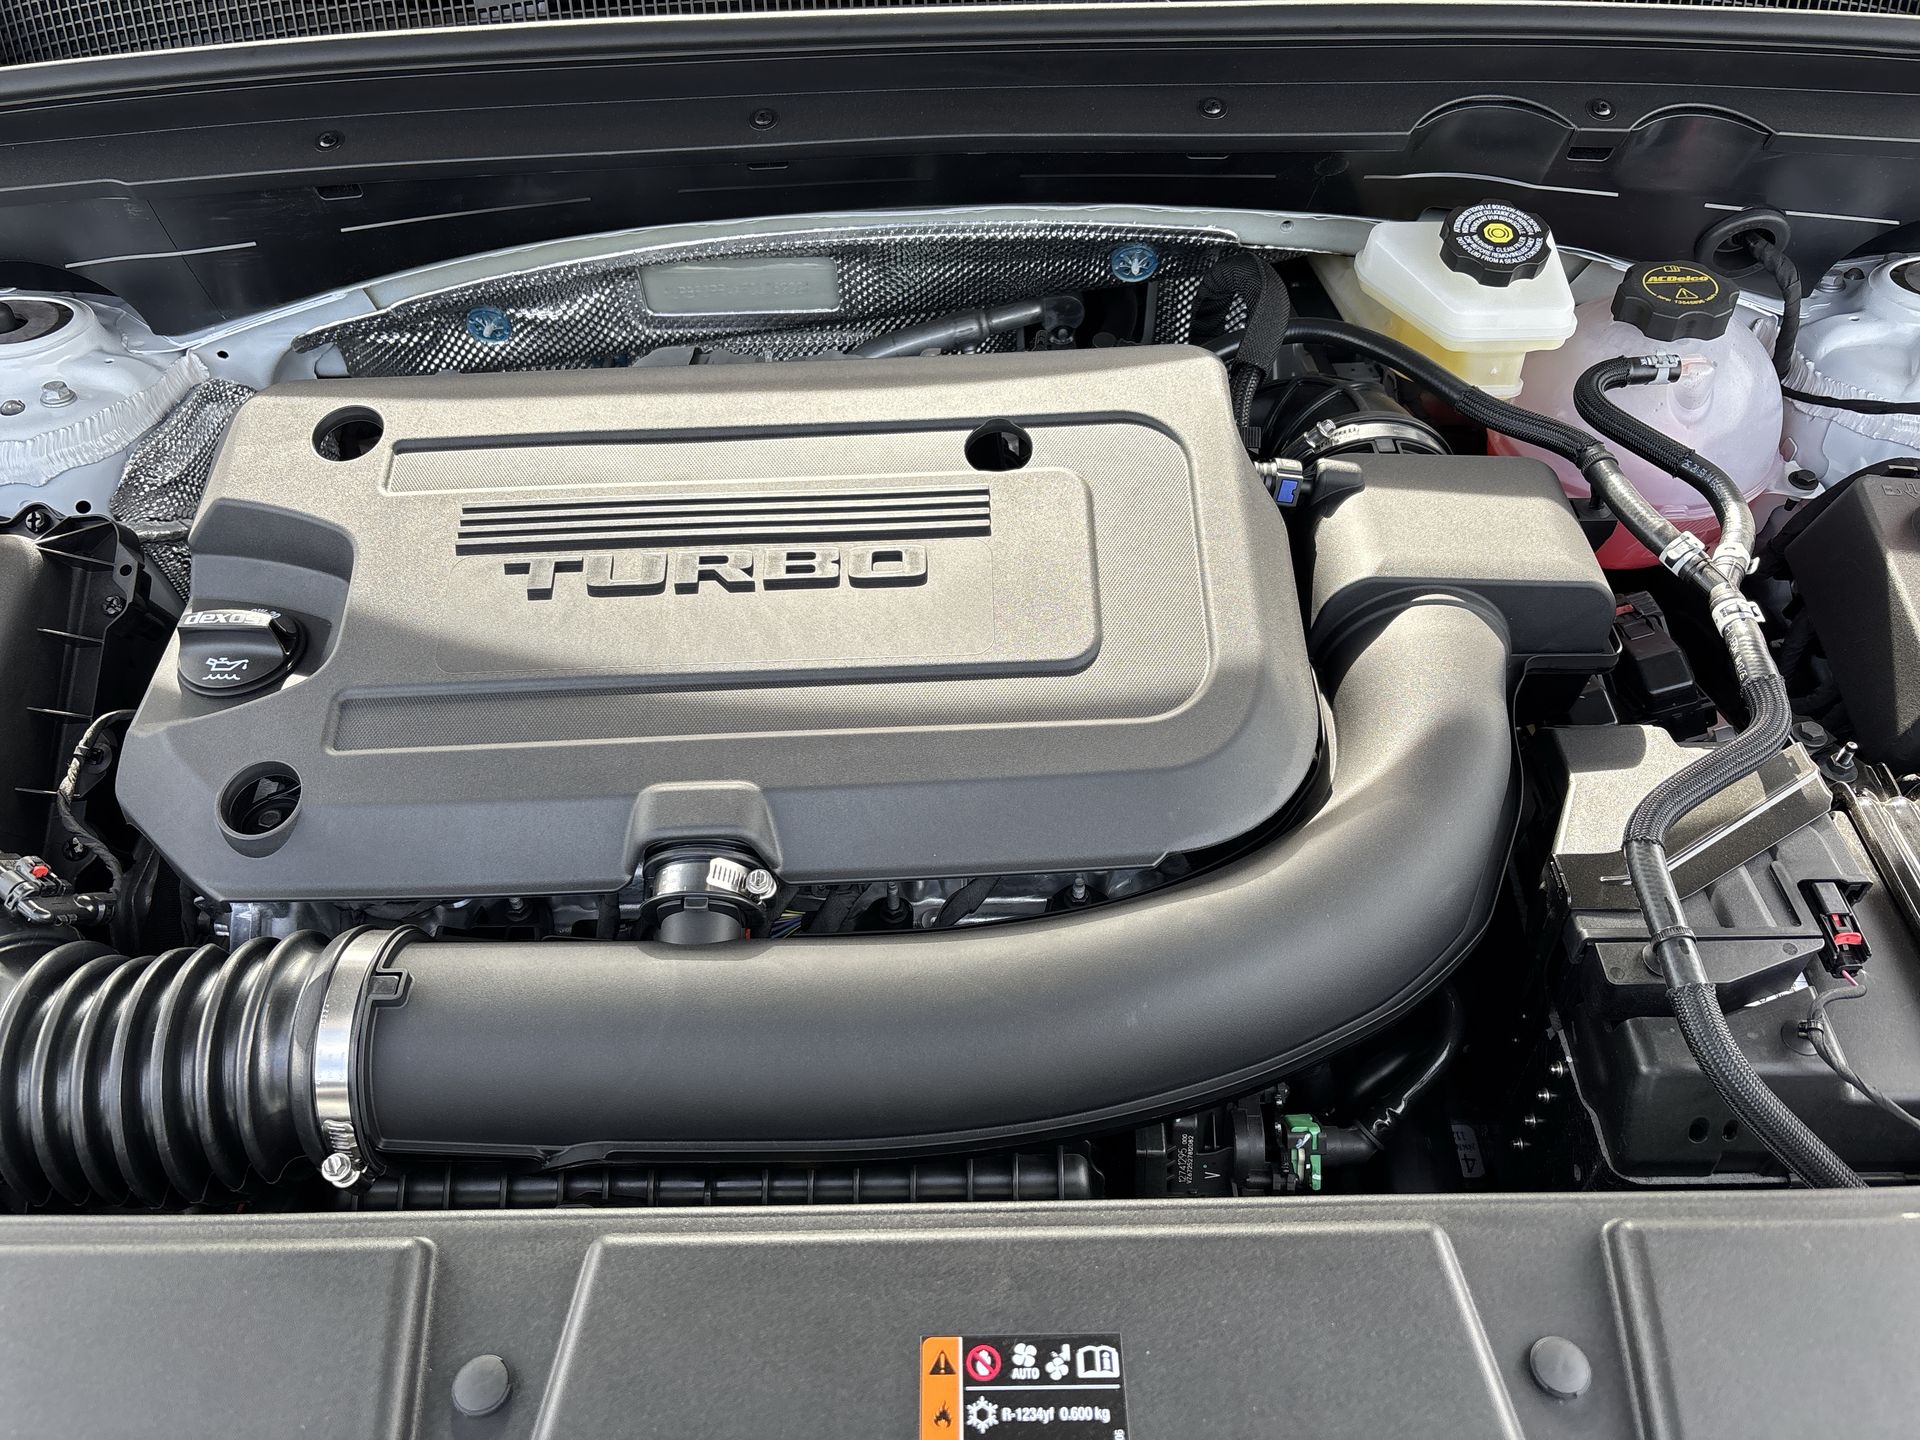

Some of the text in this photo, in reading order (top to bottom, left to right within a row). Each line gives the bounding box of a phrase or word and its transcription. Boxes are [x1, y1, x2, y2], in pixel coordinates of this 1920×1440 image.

[1480, 255, 1499, 263] FROM
[504, 546, 929, 601] TURBO
[1011, 1367, 1040, 1380] AUTO
[1001, 1405, 1111, 1425] R-1234yf 0.600 kg
